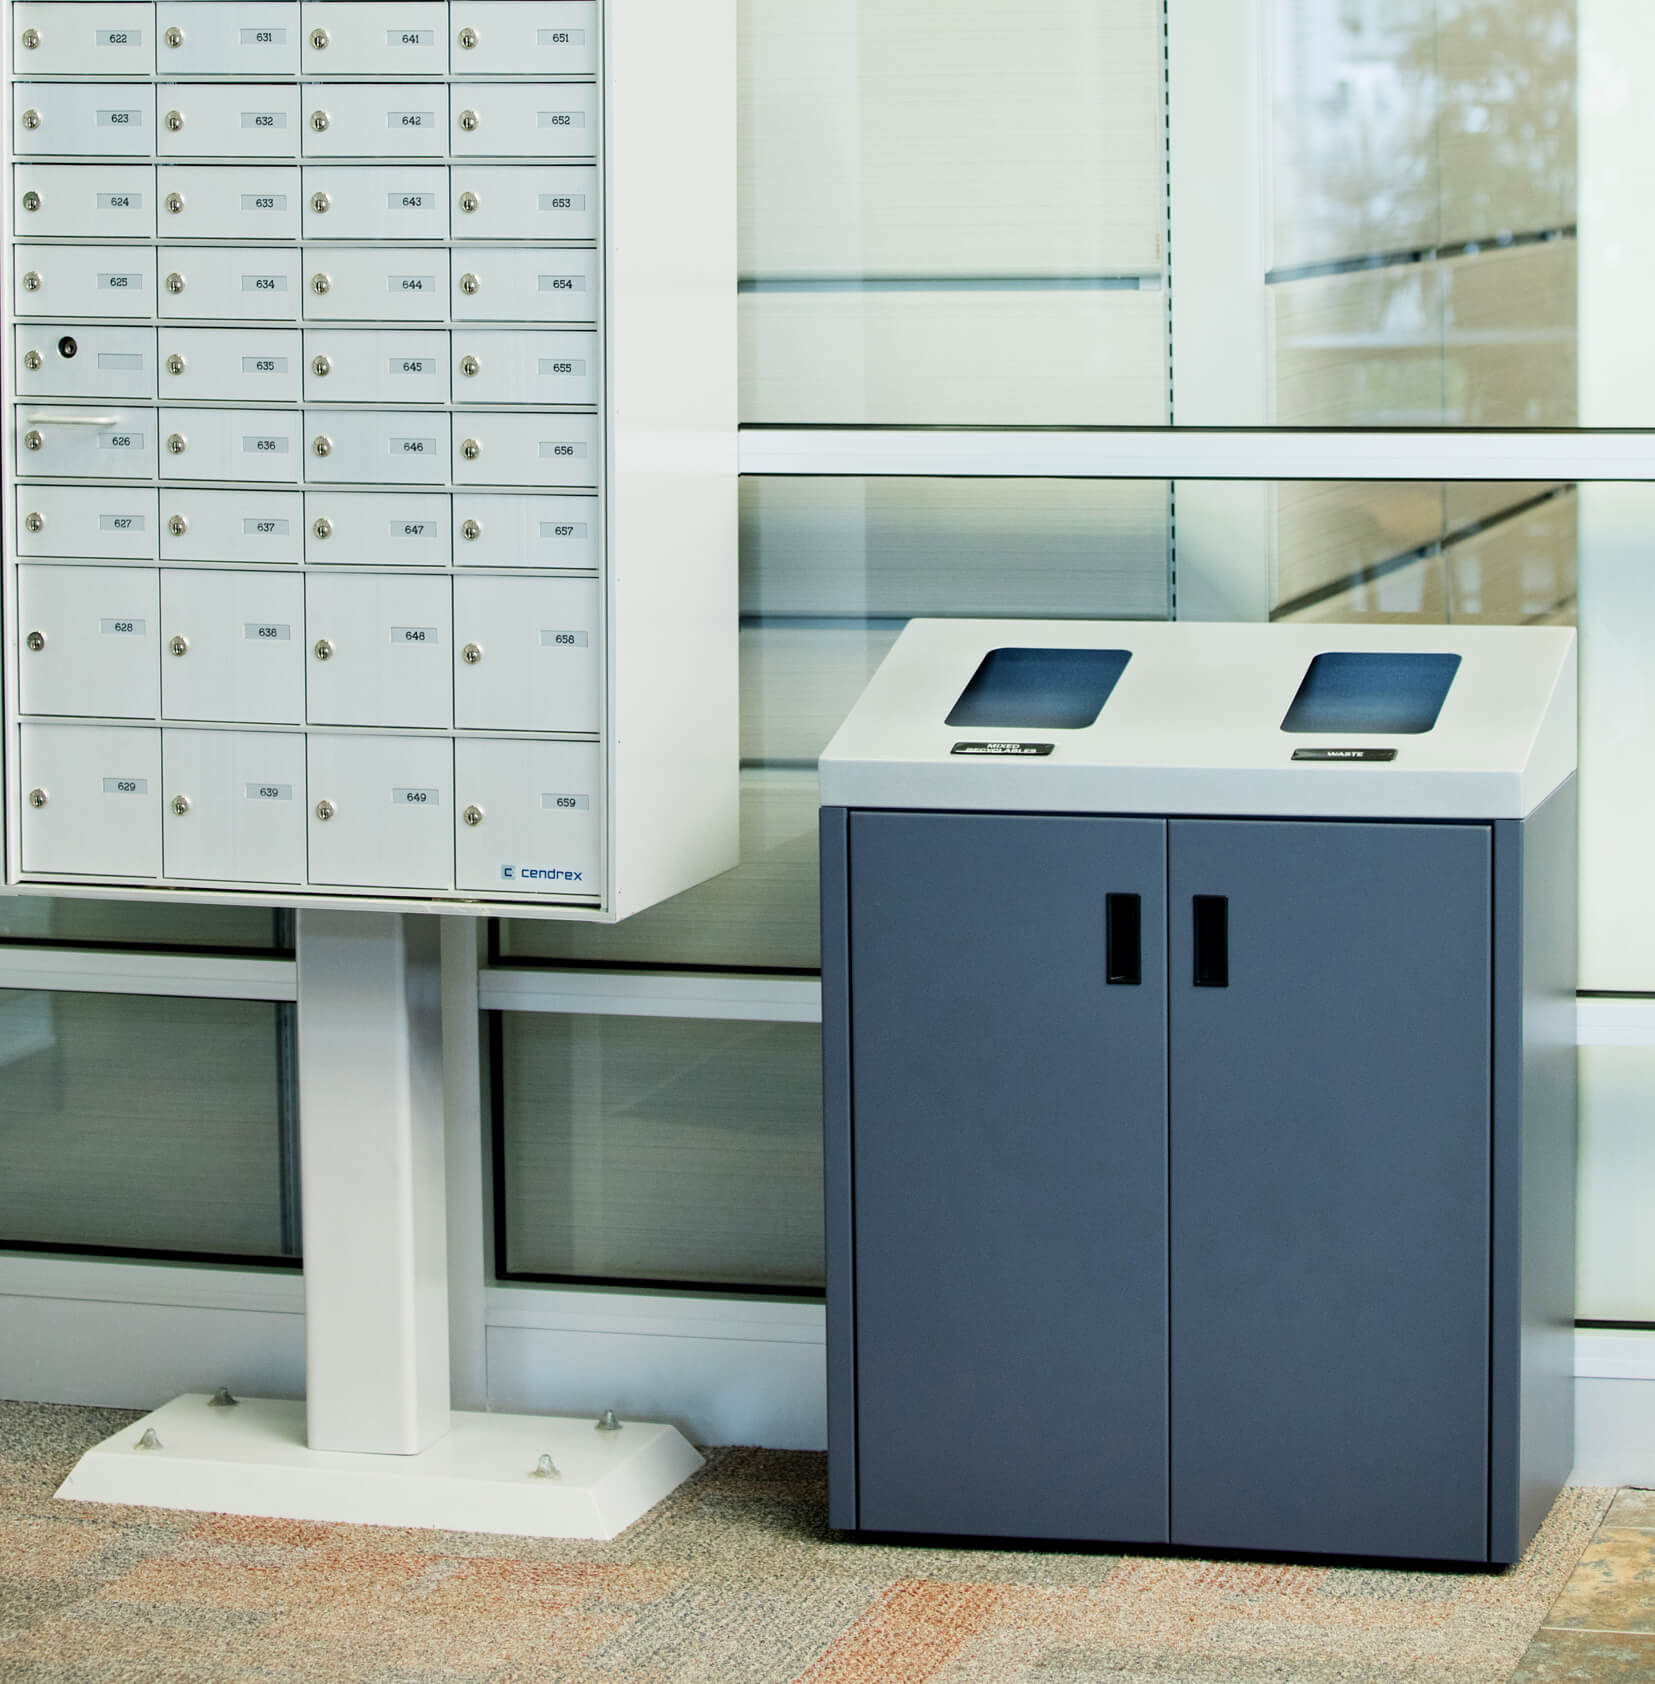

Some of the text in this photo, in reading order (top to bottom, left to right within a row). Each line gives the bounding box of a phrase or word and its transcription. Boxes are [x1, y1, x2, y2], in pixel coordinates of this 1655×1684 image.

[109, 33, 127, 44] 622
[256, 32, 272, 42] 631
[402, 34, 419, 44] 641
[552, 33, 569, 43] 651
[111, 113, 129, 123] 623
[255, 116, 274, 126] 632
[401, 116, 422, 126] 642
[551, 115, 571, 126] 652
[111, 197, 129, 207] 624
[255, 198, 274, 208] 633
[402, 197, 422, 207] 643
[552, 198, 571, 208] 653
[110, 277, 128, 287] 625
[256, 279, 275, 289] 634
[402, 280, 422, 290] 644
[553, 279, 573, 289] 654
[256, 361, 275, 371] 635
[403, 362, 422, 372] 645
[553, 363, 572, 373] 655
[112, 436, 131, 446] 626
[257, 440, 276, 450] 636
[403, 442, 424, 452] 646
[554, 445, 574, 456] 656
[114, 519, 132, 528] 627
[257, 522, 275, 533] 637
[404, 525, 424, 535] 647
[554, 526, 574, 536] 657
[114, 622, 133, 632] 628
[258, 627, 277, 638] 638
[405, 631, 426, 641] 648
[555, 634, 575, 645] 658
[117, 781, 136, 792] 629
[259, 787, 279, 798] 639
[406, 792, 427, 802] 649
[556, 797, 576, 808] 659
[521, 868, 583, 881] cendrex
